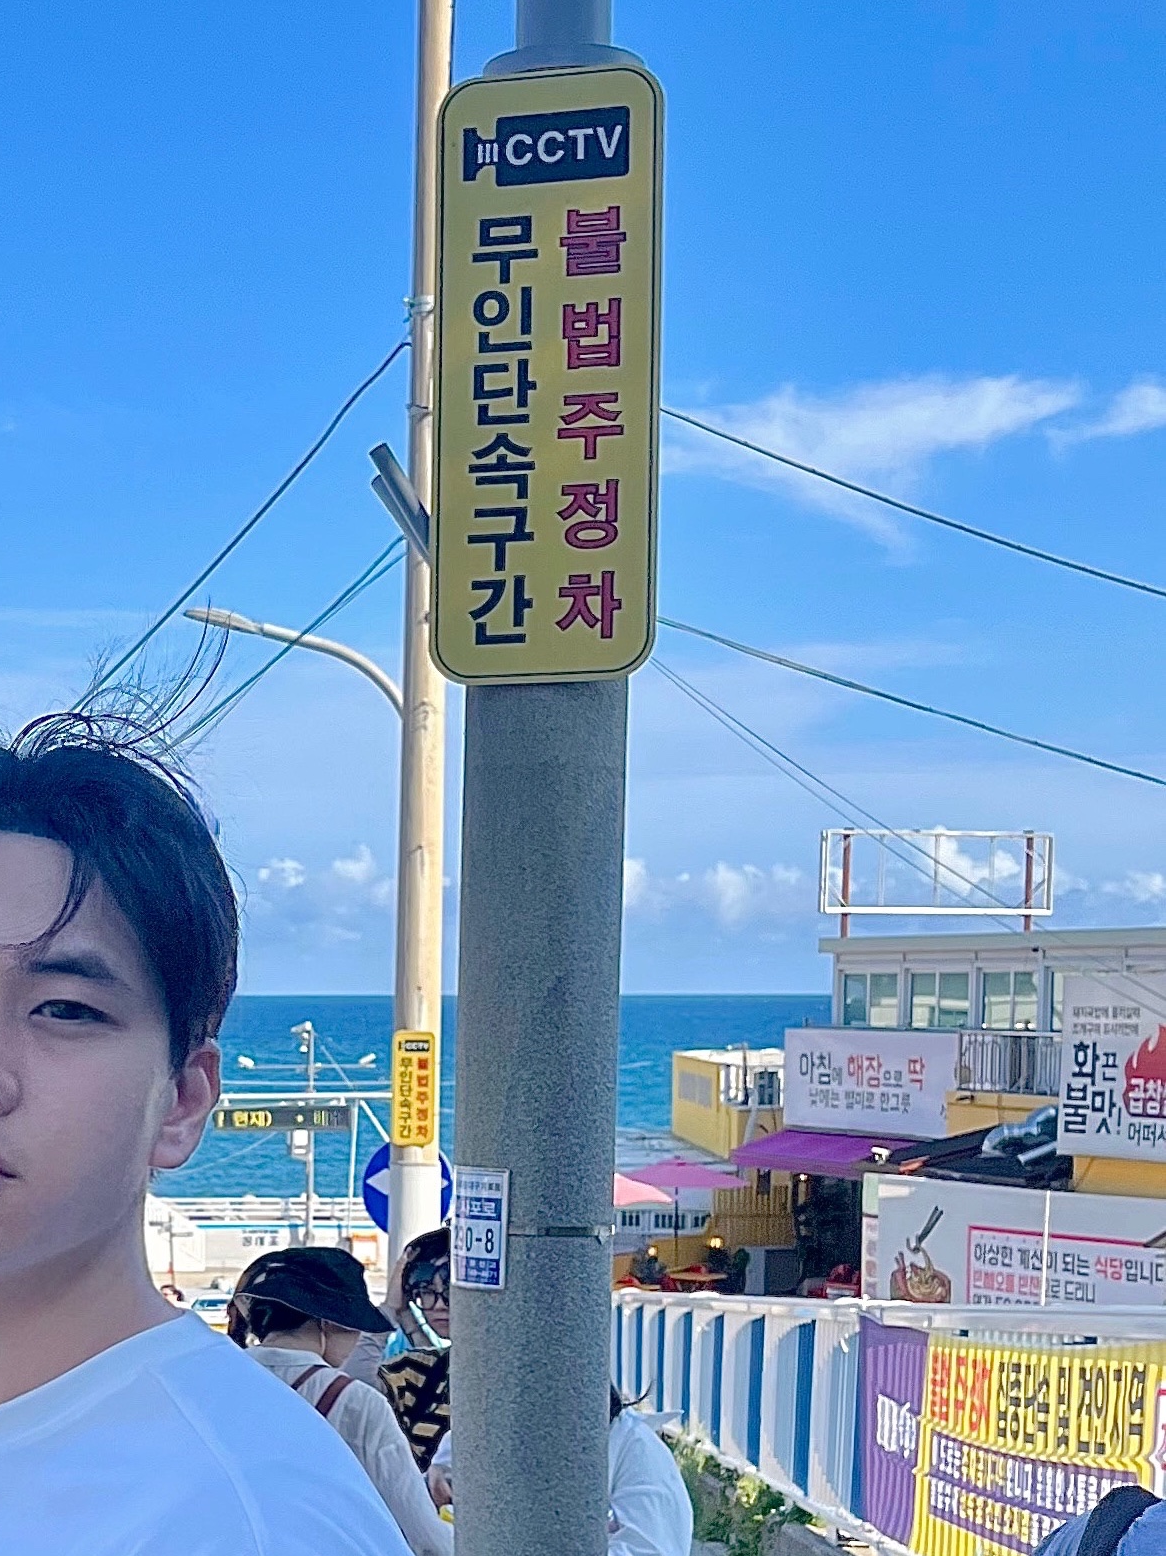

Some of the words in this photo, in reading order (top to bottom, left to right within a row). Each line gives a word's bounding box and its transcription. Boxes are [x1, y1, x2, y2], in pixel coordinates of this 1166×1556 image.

[505, 125, 624, 166] CCTV
[468, 215, 538, 645] 무인단속구간
[556, 206, 626, 639] 불법주정차
[799, 1051, 843, 1085] 아침에
[847, 1053, 903, 1088] 해장으로
[907, 1054, 925, 1091] 딱
[1072, 1041, 1118, 1086] 화끈
[1063, 1083, 1122, 1135] 불맛!
[1129, 1078, 1166, 1115] 곱창
[974, 1243, 1012, 1267] 이상한
[1017, 1248, 1058, 1273] 계산이
[1062, 1253, 1090, 1277] 되는
